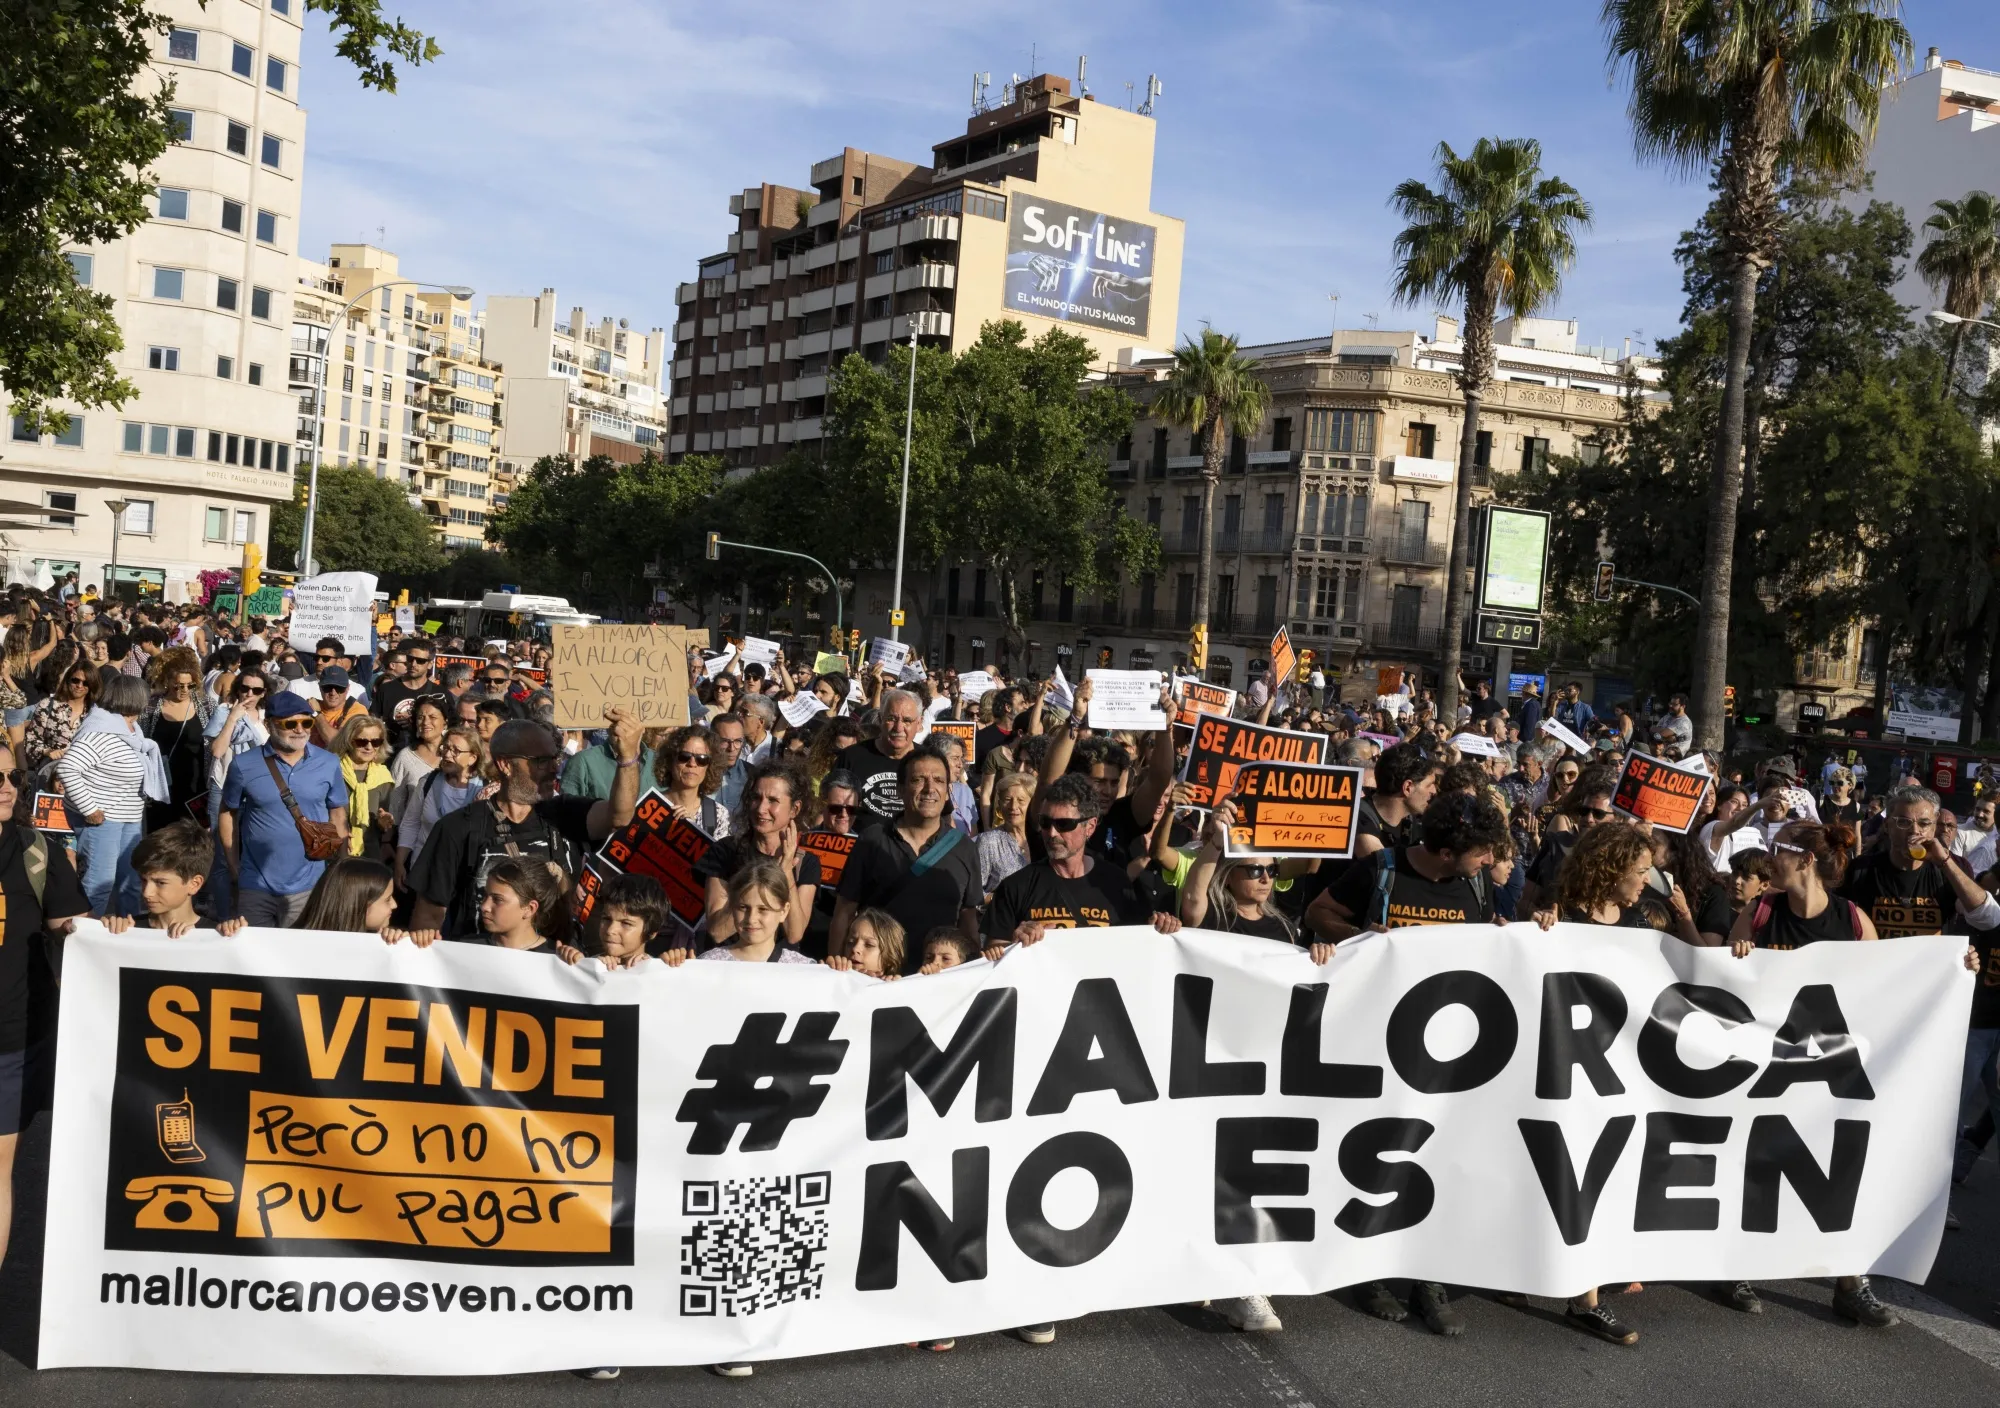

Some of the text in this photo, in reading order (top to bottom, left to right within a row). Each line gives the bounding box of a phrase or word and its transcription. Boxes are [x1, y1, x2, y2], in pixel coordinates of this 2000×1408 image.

[1017, 292, 1136, 326] EL MUNDO EN TUS MANOS
[206, 470, 289, 488] HOTEL PALACIO AVENIDA
[316, 594, 344, 602] Besuch!
[294, 623, 347, 631] wiederzusehen
[563, 625, 655, 646] ESTIMAM
[558, 643, 673, 672] MALLORCA
[590, 673, 669, 698] VOLEM
[1803, 705, 1824, 717] GOIKO
[1199, 721, 1319, 765] SE ALQUILA
[1237, 769, 1259, 796] SE
[1263, 770, 1352, 800] ALQUILA
[1628, 758, 1705, 797] SE ALQUILA
[37, 797, 51, 809] SE
[1284, 810, 1304, 822] NO
[637, 798, 710, 864] SE VEN
[806, 832, 857, 853] VENDE
[1272, 830, 1327, 844] PAGAR
[580, 870, 597, 893] SE
[1030, 906, 1110, 920] MALLRCA
[1389, 903, 1466, 920] MALLORCA
[1876, 909, 1937, 923] NO ES
[144, 984, 605, 1099] SE VENDE
[675, 969, 1876, 1155] #MALLORCA
[253, 1104, 601, 1174] Però no ho
[855, 1111, 1871, 1292] NO ES VEN
[395, 1186, 580, 1248] pagar
[101, 1266, 634, 1314] mallorcanoesven.com
